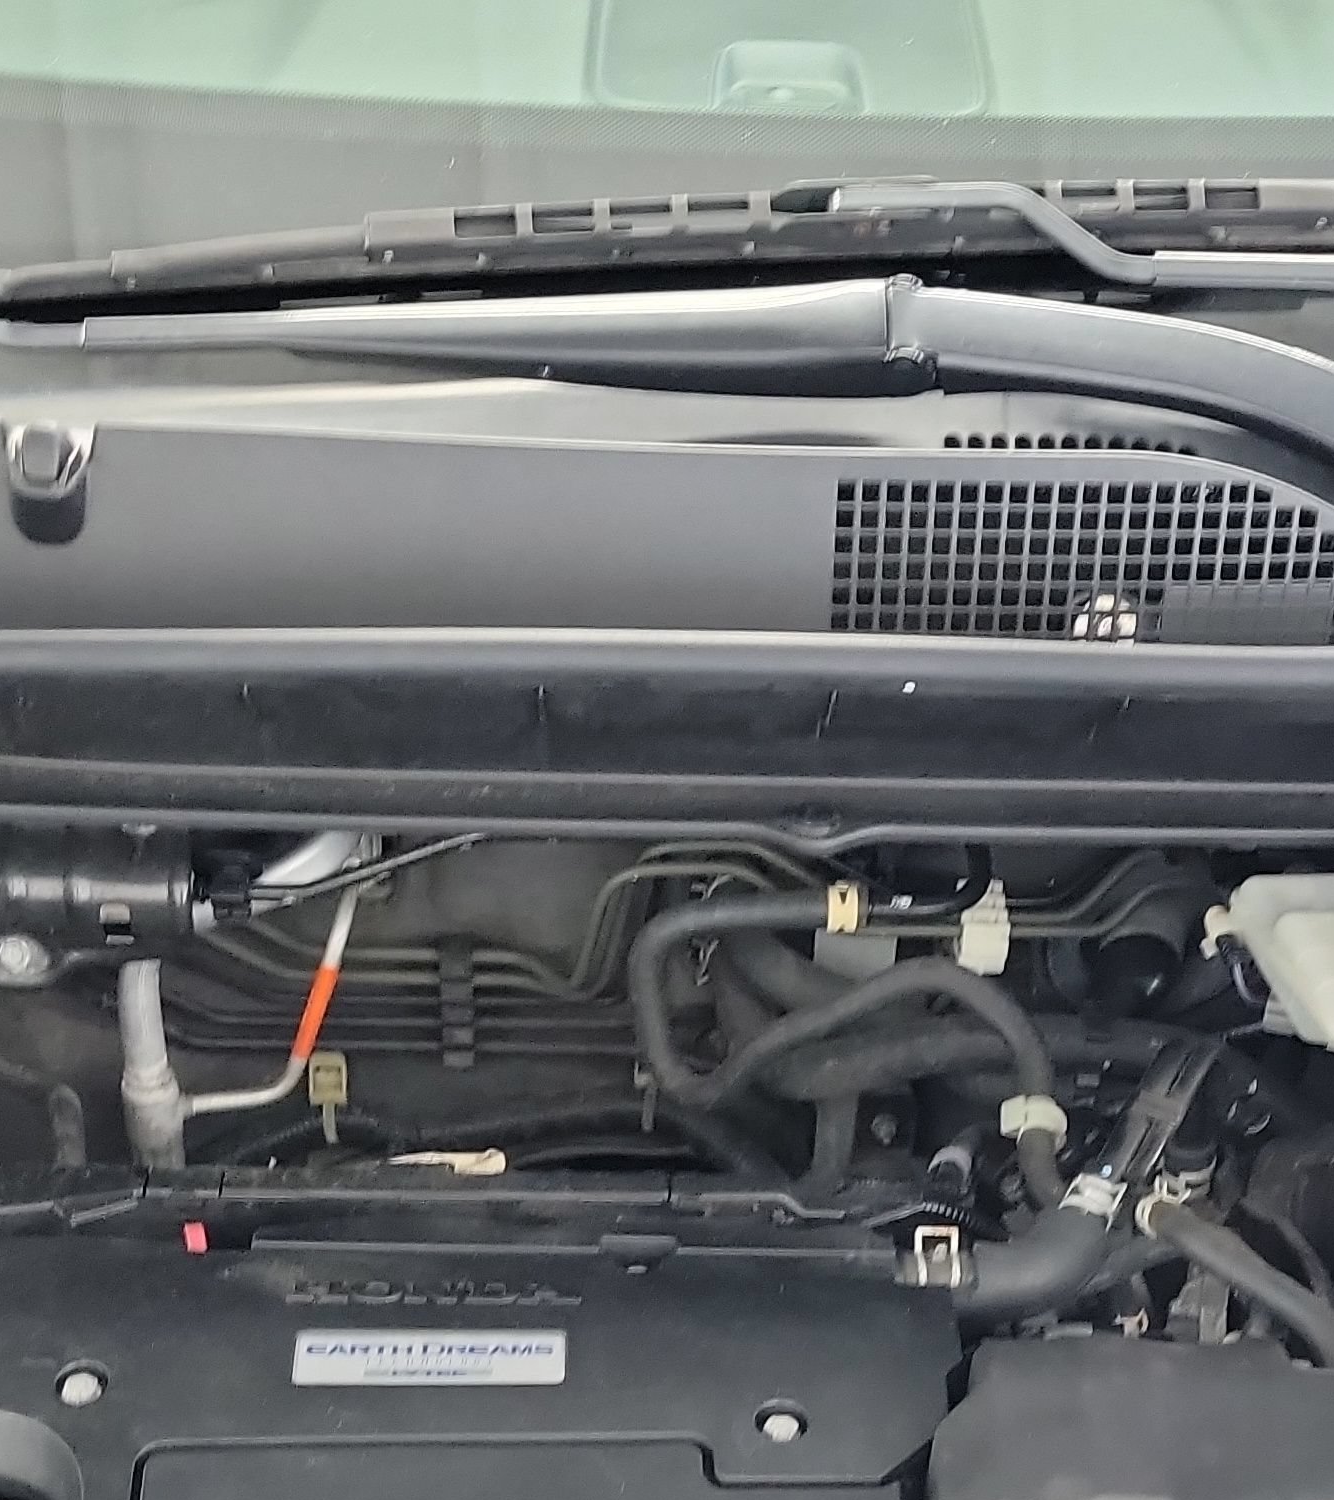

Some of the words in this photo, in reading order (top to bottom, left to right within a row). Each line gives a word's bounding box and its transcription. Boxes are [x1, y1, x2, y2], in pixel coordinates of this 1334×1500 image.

[285, 1280, 582, 1305] HONDA
[306, 1343, 413, 1356] EARTH
[417, 1342, 554, 1356] DREAMS
